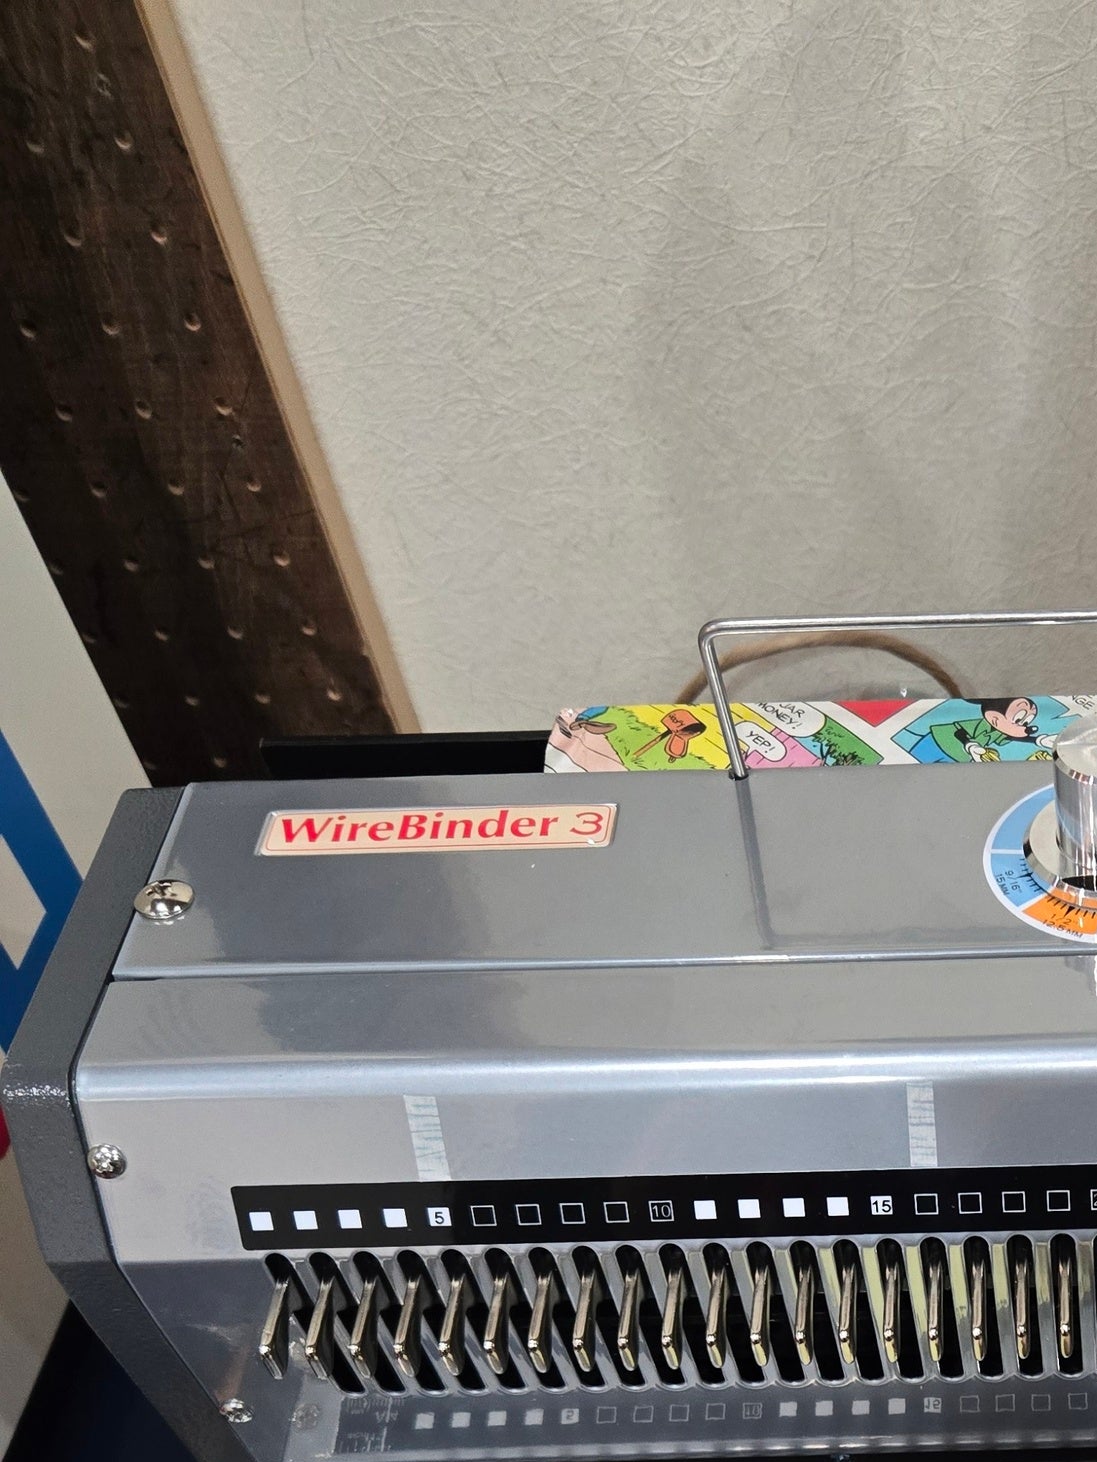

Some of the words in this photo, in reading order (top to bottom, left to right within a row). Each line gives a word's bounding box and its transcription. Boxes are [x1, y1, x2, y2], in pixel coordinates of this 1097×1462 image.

[779, 703, 806, 718] JAR
[745, 730, 776, 753] YEP!
[281, 810, 560, 844] WireBinder
[569, 811, 604, 836] 3
[651, 1204, 672, 1220] 10
[871, 1198, 892, 1215] 15
[434, 1212, 446, 1226] 5
